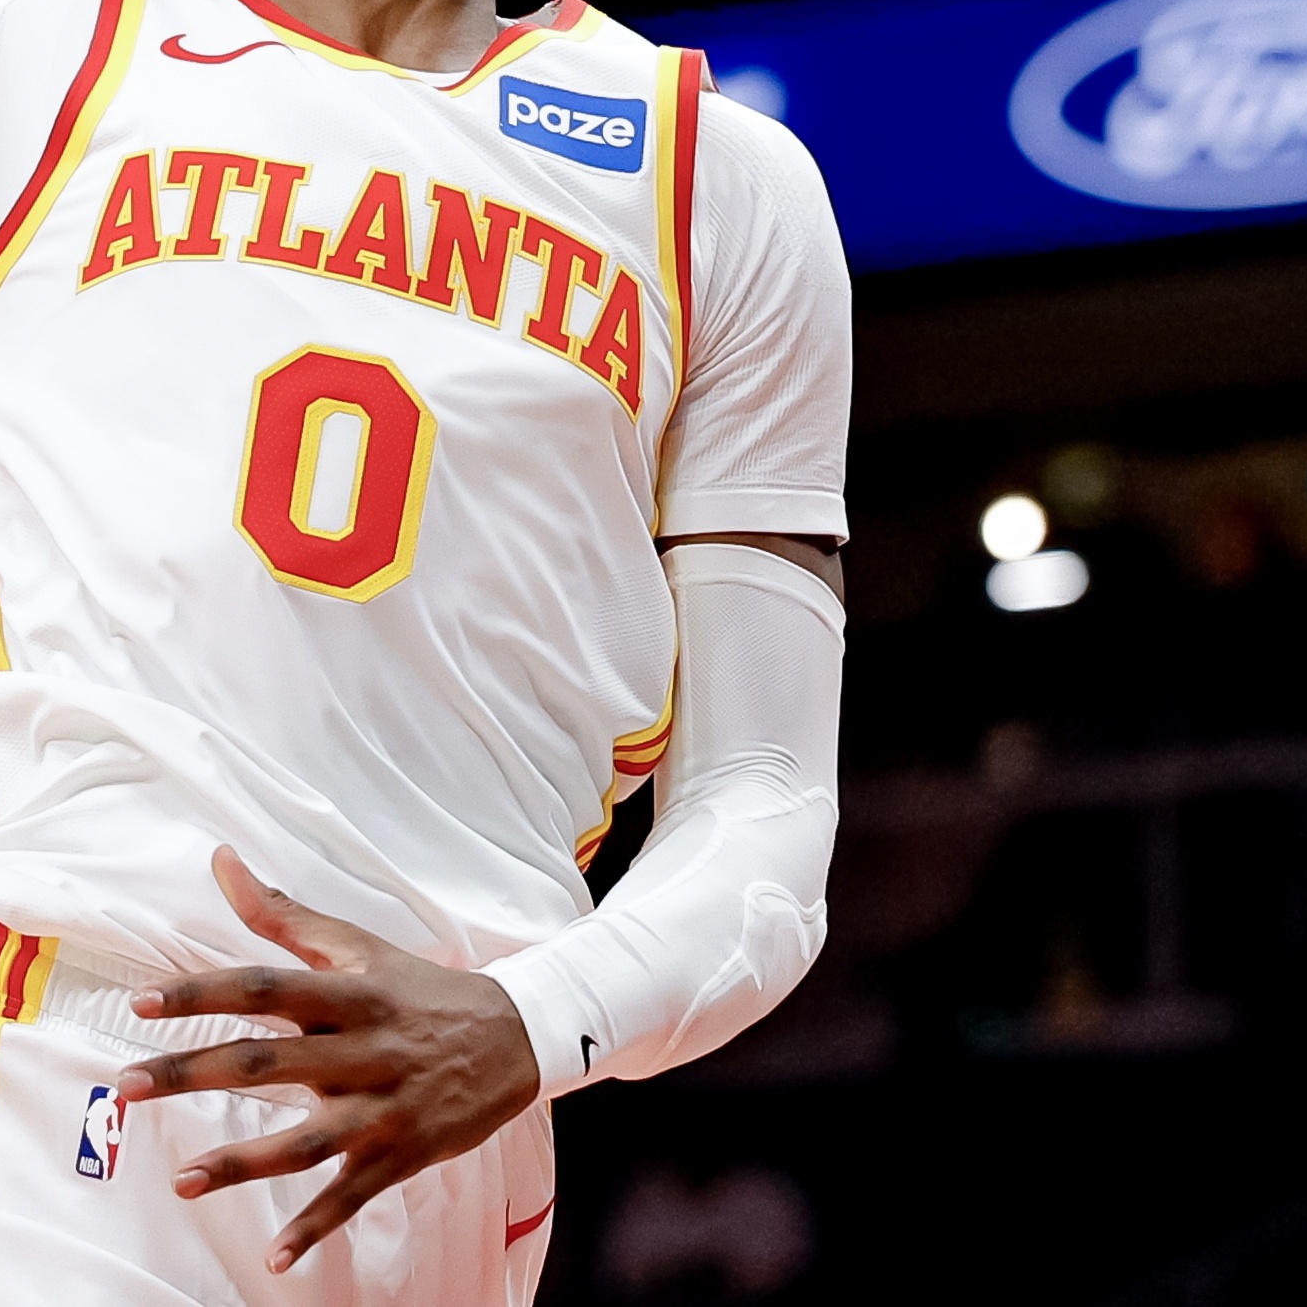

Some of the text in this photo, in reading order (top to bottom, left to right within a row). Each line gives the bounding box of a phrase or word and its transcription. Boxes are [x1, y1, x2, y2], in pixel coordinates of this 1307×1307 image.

[507, 92, 636, 148] paze
[75, 147, 646, 425] ATLANTA
[231, 342, 438, 605] 0
[78, 1155, 101, 1176] NBA
